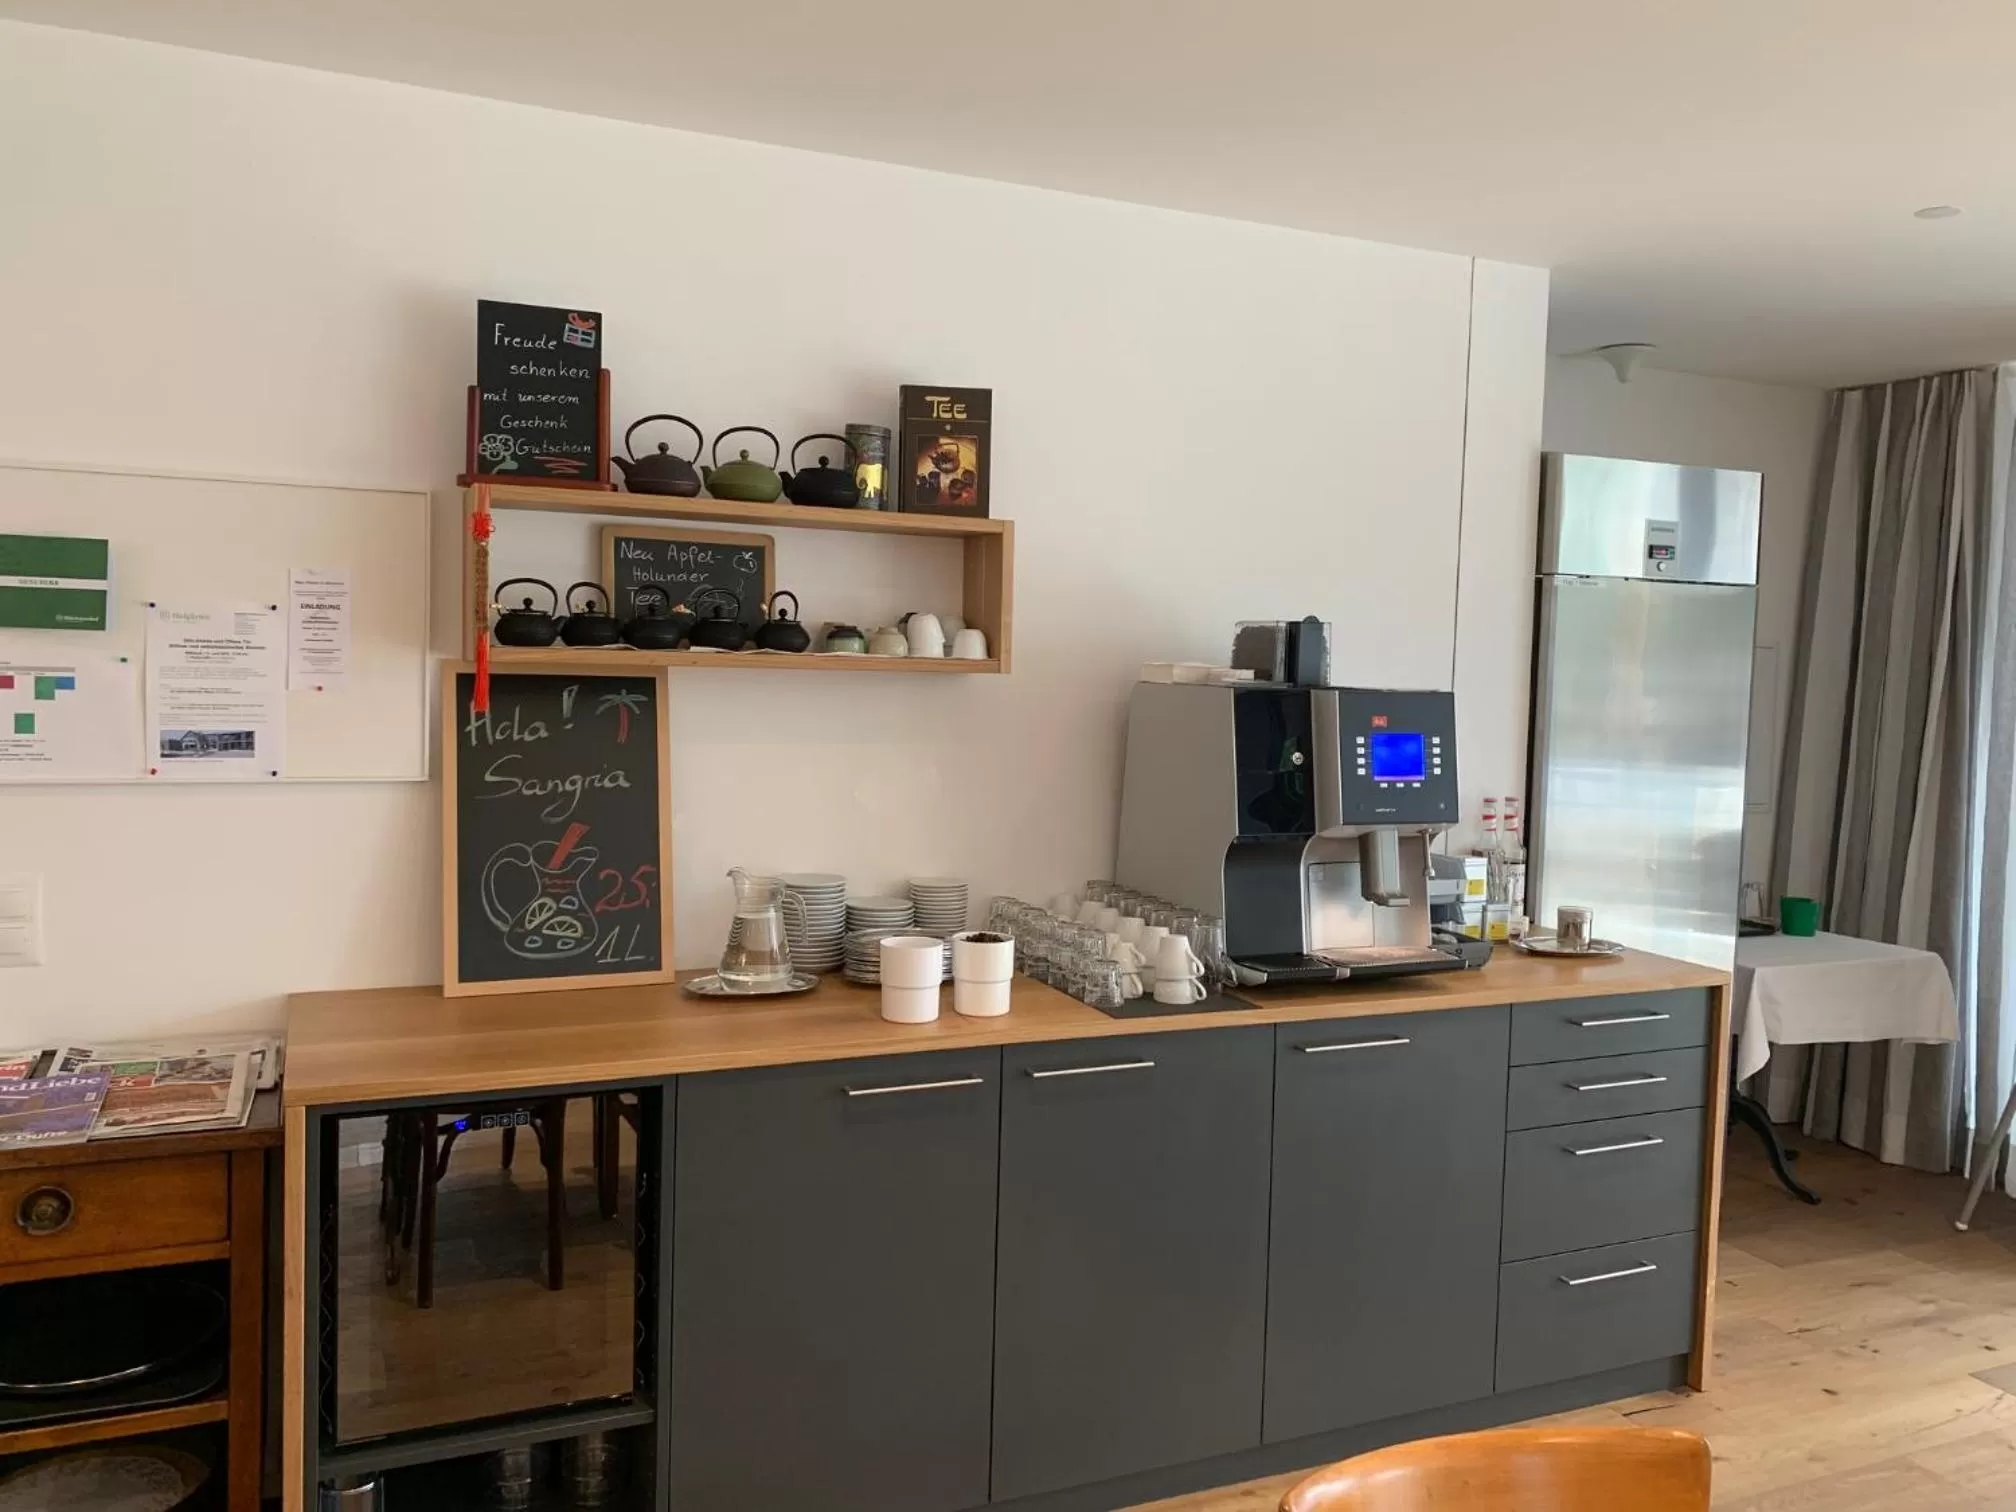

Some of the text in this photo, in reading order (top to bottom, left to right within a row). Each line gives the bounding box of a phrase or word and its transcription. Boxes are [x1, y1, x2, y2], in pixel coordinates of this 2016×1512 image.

[494, 323, 558, 350] Freude
[510, 360, 592, 380] schenken
[483, 388, 580, 405] mit unserem
[500, 414, 569, 430] Geschenk
[515, 438, 593, 456] Gutschein
[619, 541, 724, 568] Neu Apfel-
[632, 566, 710, 584] Holunder
[626, 586, 662, 606] Tee
[464, 700, 550, 747] Hola
[474, 754, 632, 823] Sangria
